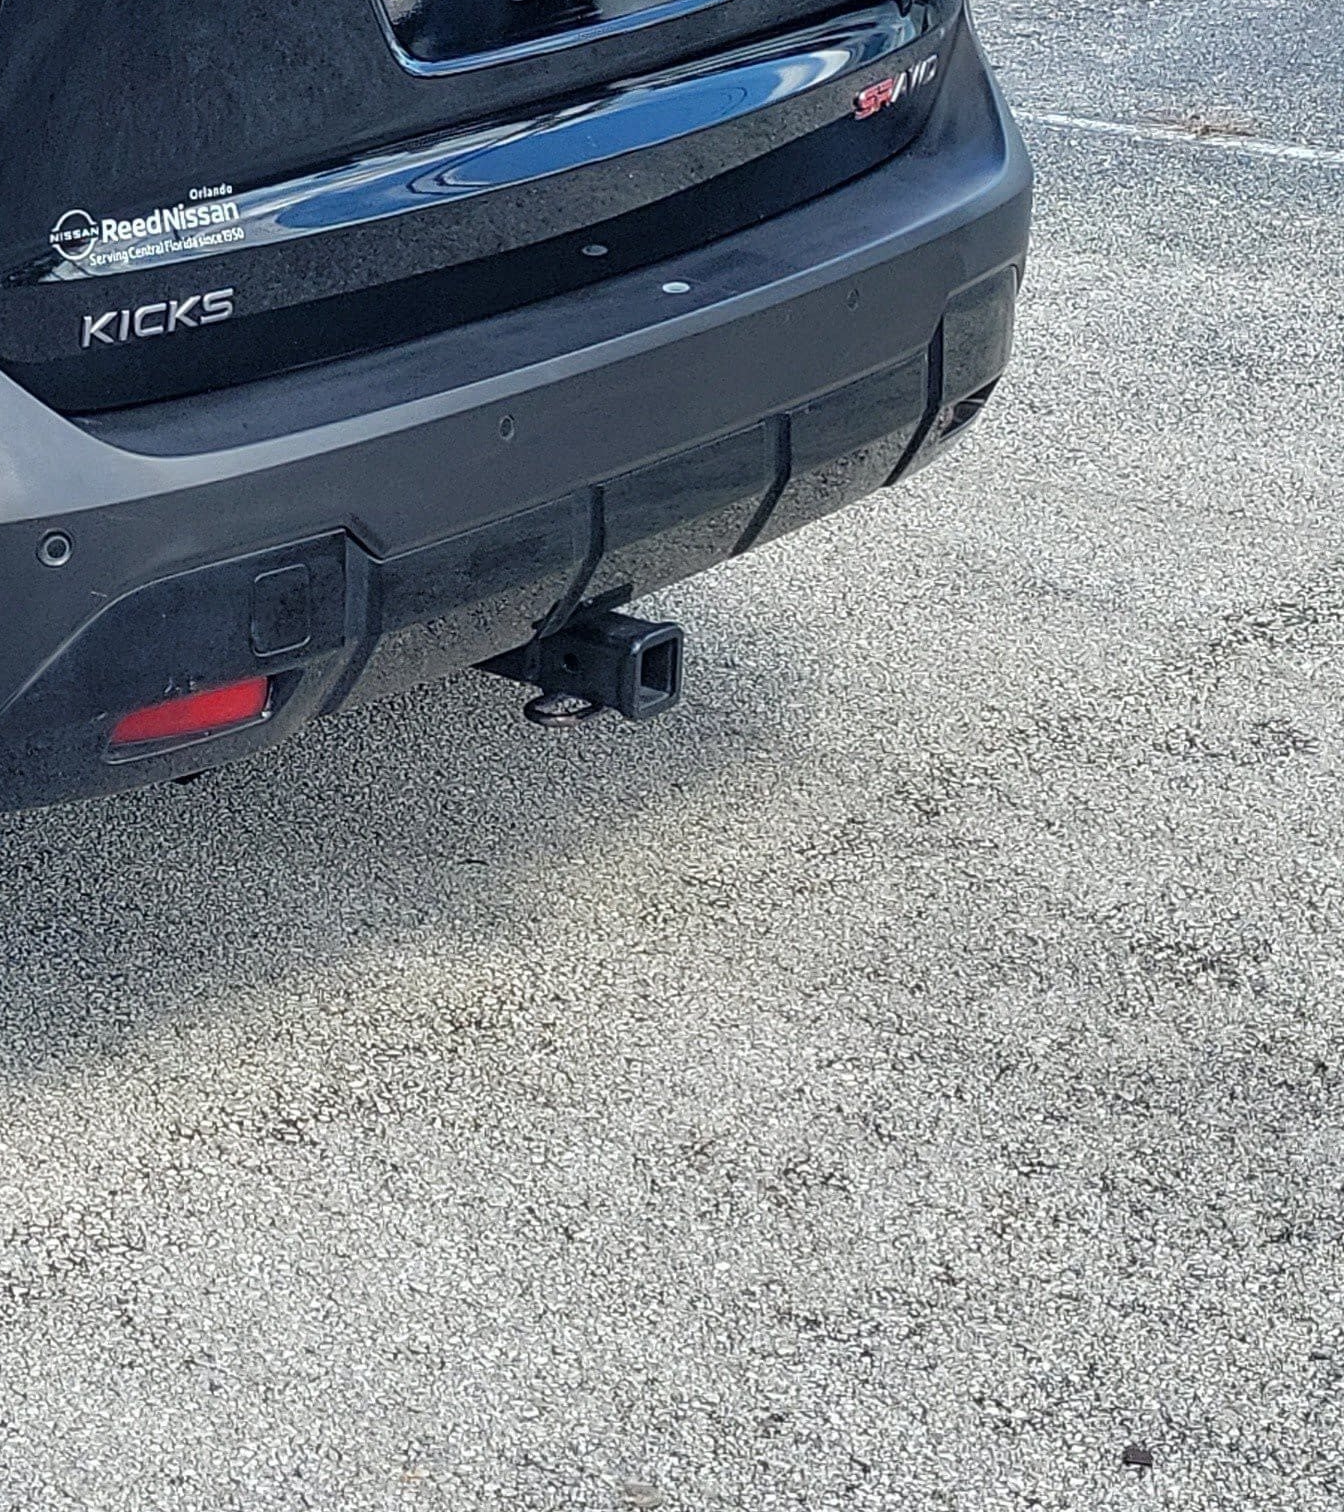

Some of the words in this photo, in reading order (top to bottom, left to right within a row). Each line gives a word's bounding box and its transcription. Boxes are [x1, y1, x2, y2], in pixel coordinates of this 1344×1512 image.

[189, 183, 233, 200] Orlando
[49, 226, 99, 244] NISSAN
[89, 249, 128, 267] Serving
[128, 242, 163, 260] Central
[80, 288, 235, 349] KICKS
